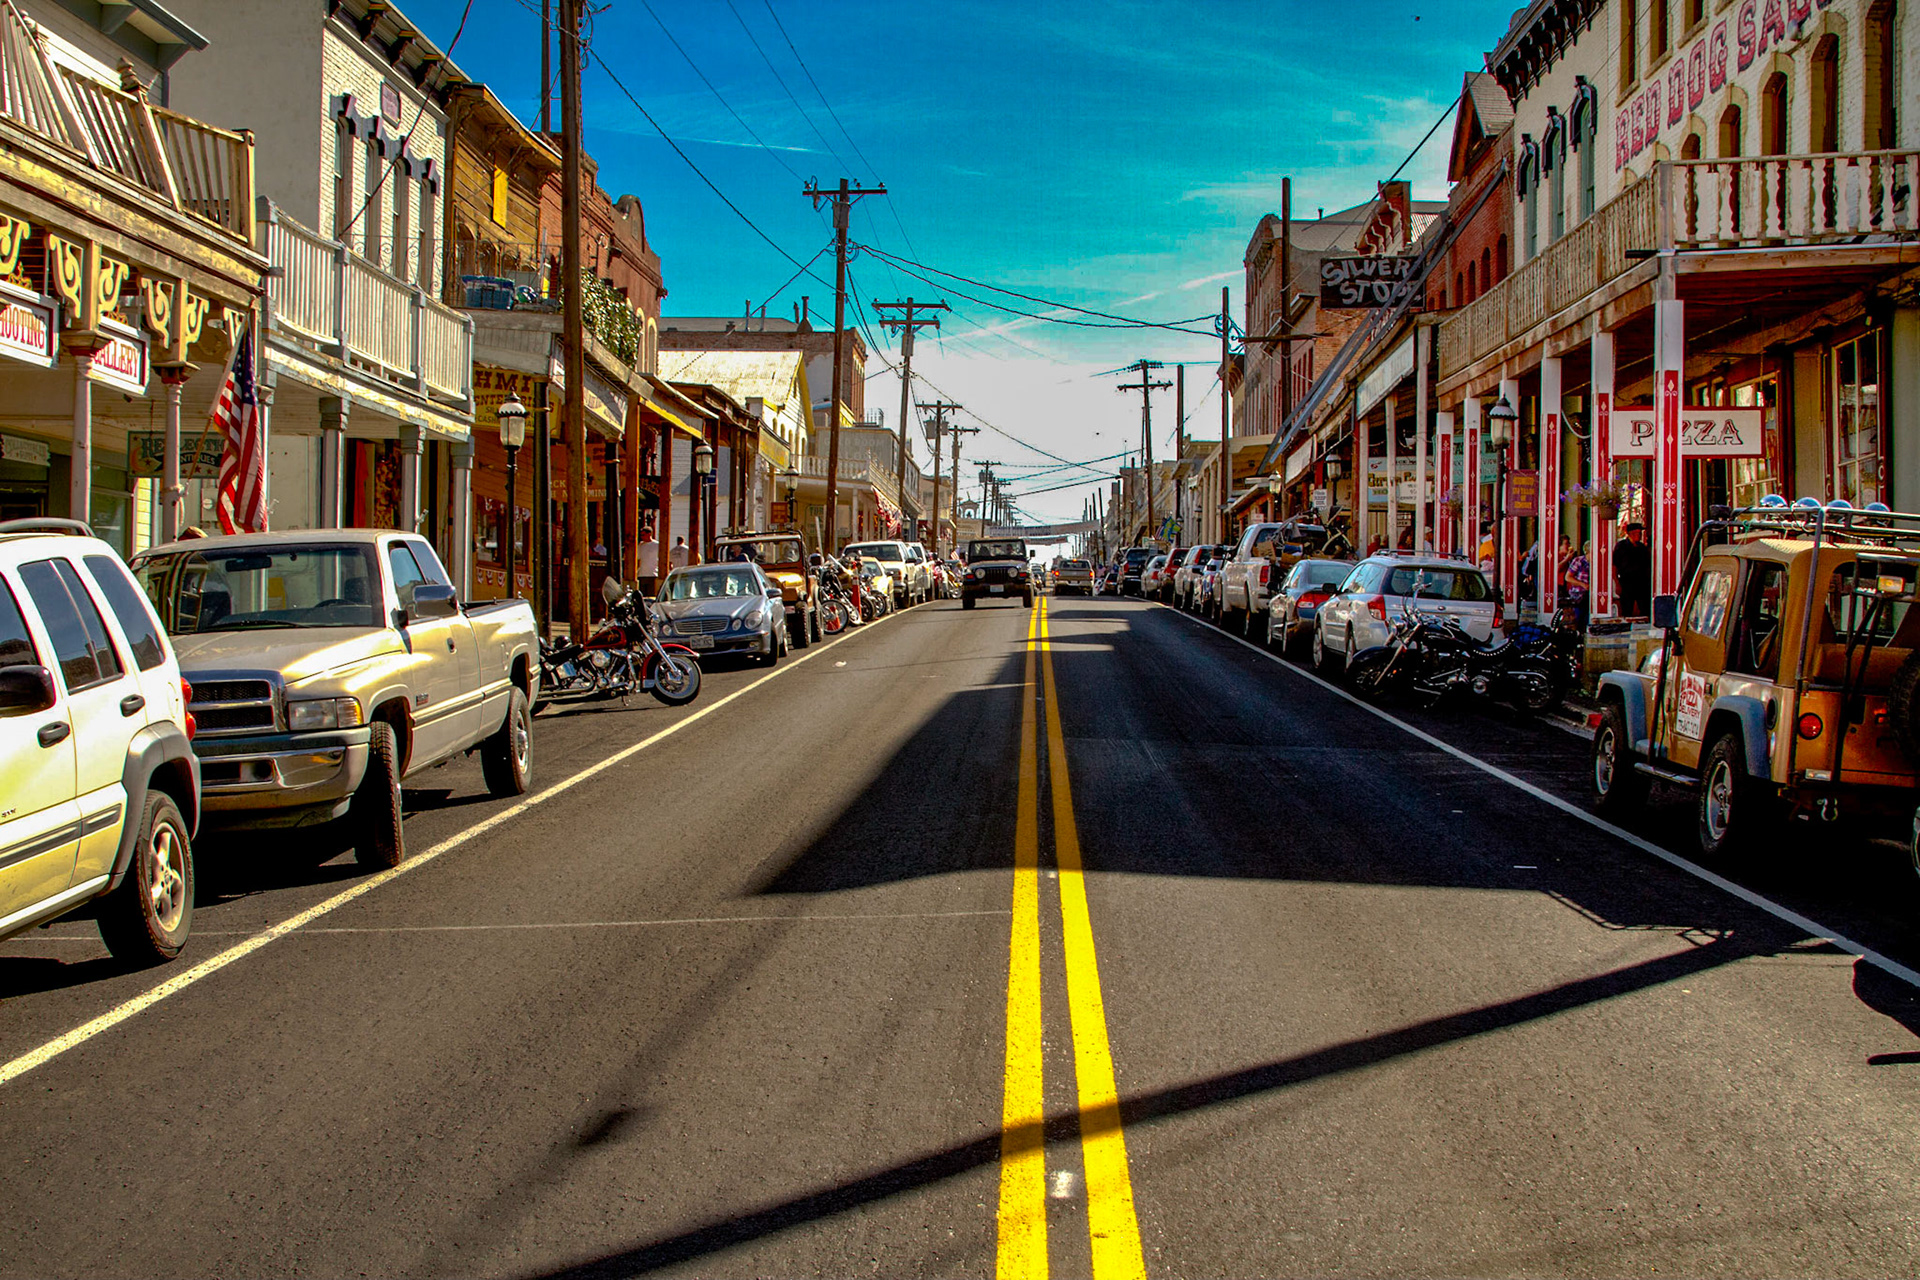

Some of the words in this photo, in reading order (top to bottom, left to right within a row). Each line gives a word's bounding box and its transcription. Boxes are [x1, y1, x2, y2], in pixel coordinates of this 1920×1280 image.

[1615, 79, 1661, 173] RED
[1667, 20, 1729, 130] DOG
[1321, 258, 1411, 287] SILVER
[474, 370, 532, 393] HMI
[474, 394, 555, 413] ENTERIS
[1630, 418, 1744, 447] PZA
